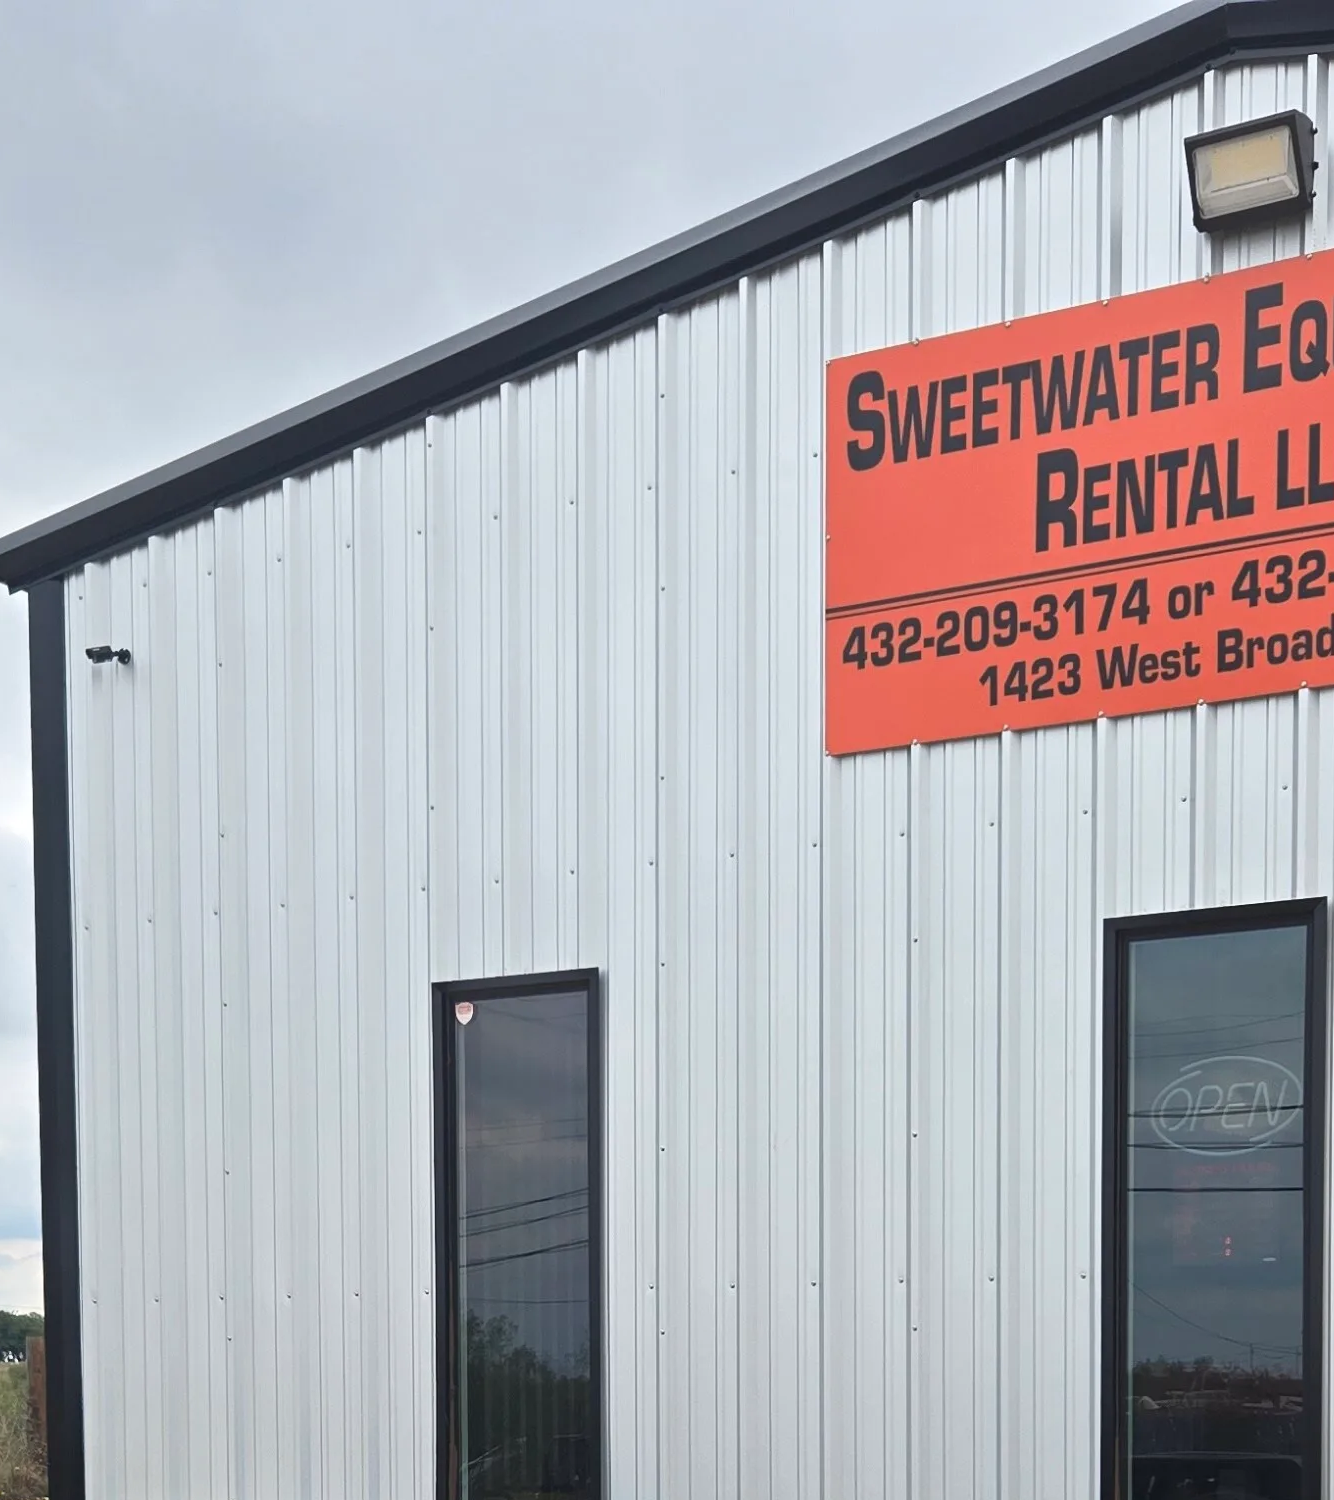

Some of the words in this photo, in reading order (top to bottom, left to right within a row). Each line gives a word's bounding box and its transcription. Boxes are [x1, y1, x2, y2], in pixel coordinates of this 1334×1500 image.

[847, 322, 1219, 472] SWEETWATER
[1035, 438, 1255, 553] RENTAL
[842, 578, 1151, 670] 432-209-3174
[1167, 580, 1215, 620] or
[979, 653, 1081, 707] 1423
[1096, 641, 1201, 690] West
[1158, 1078, 1289, 1133] OPEN
